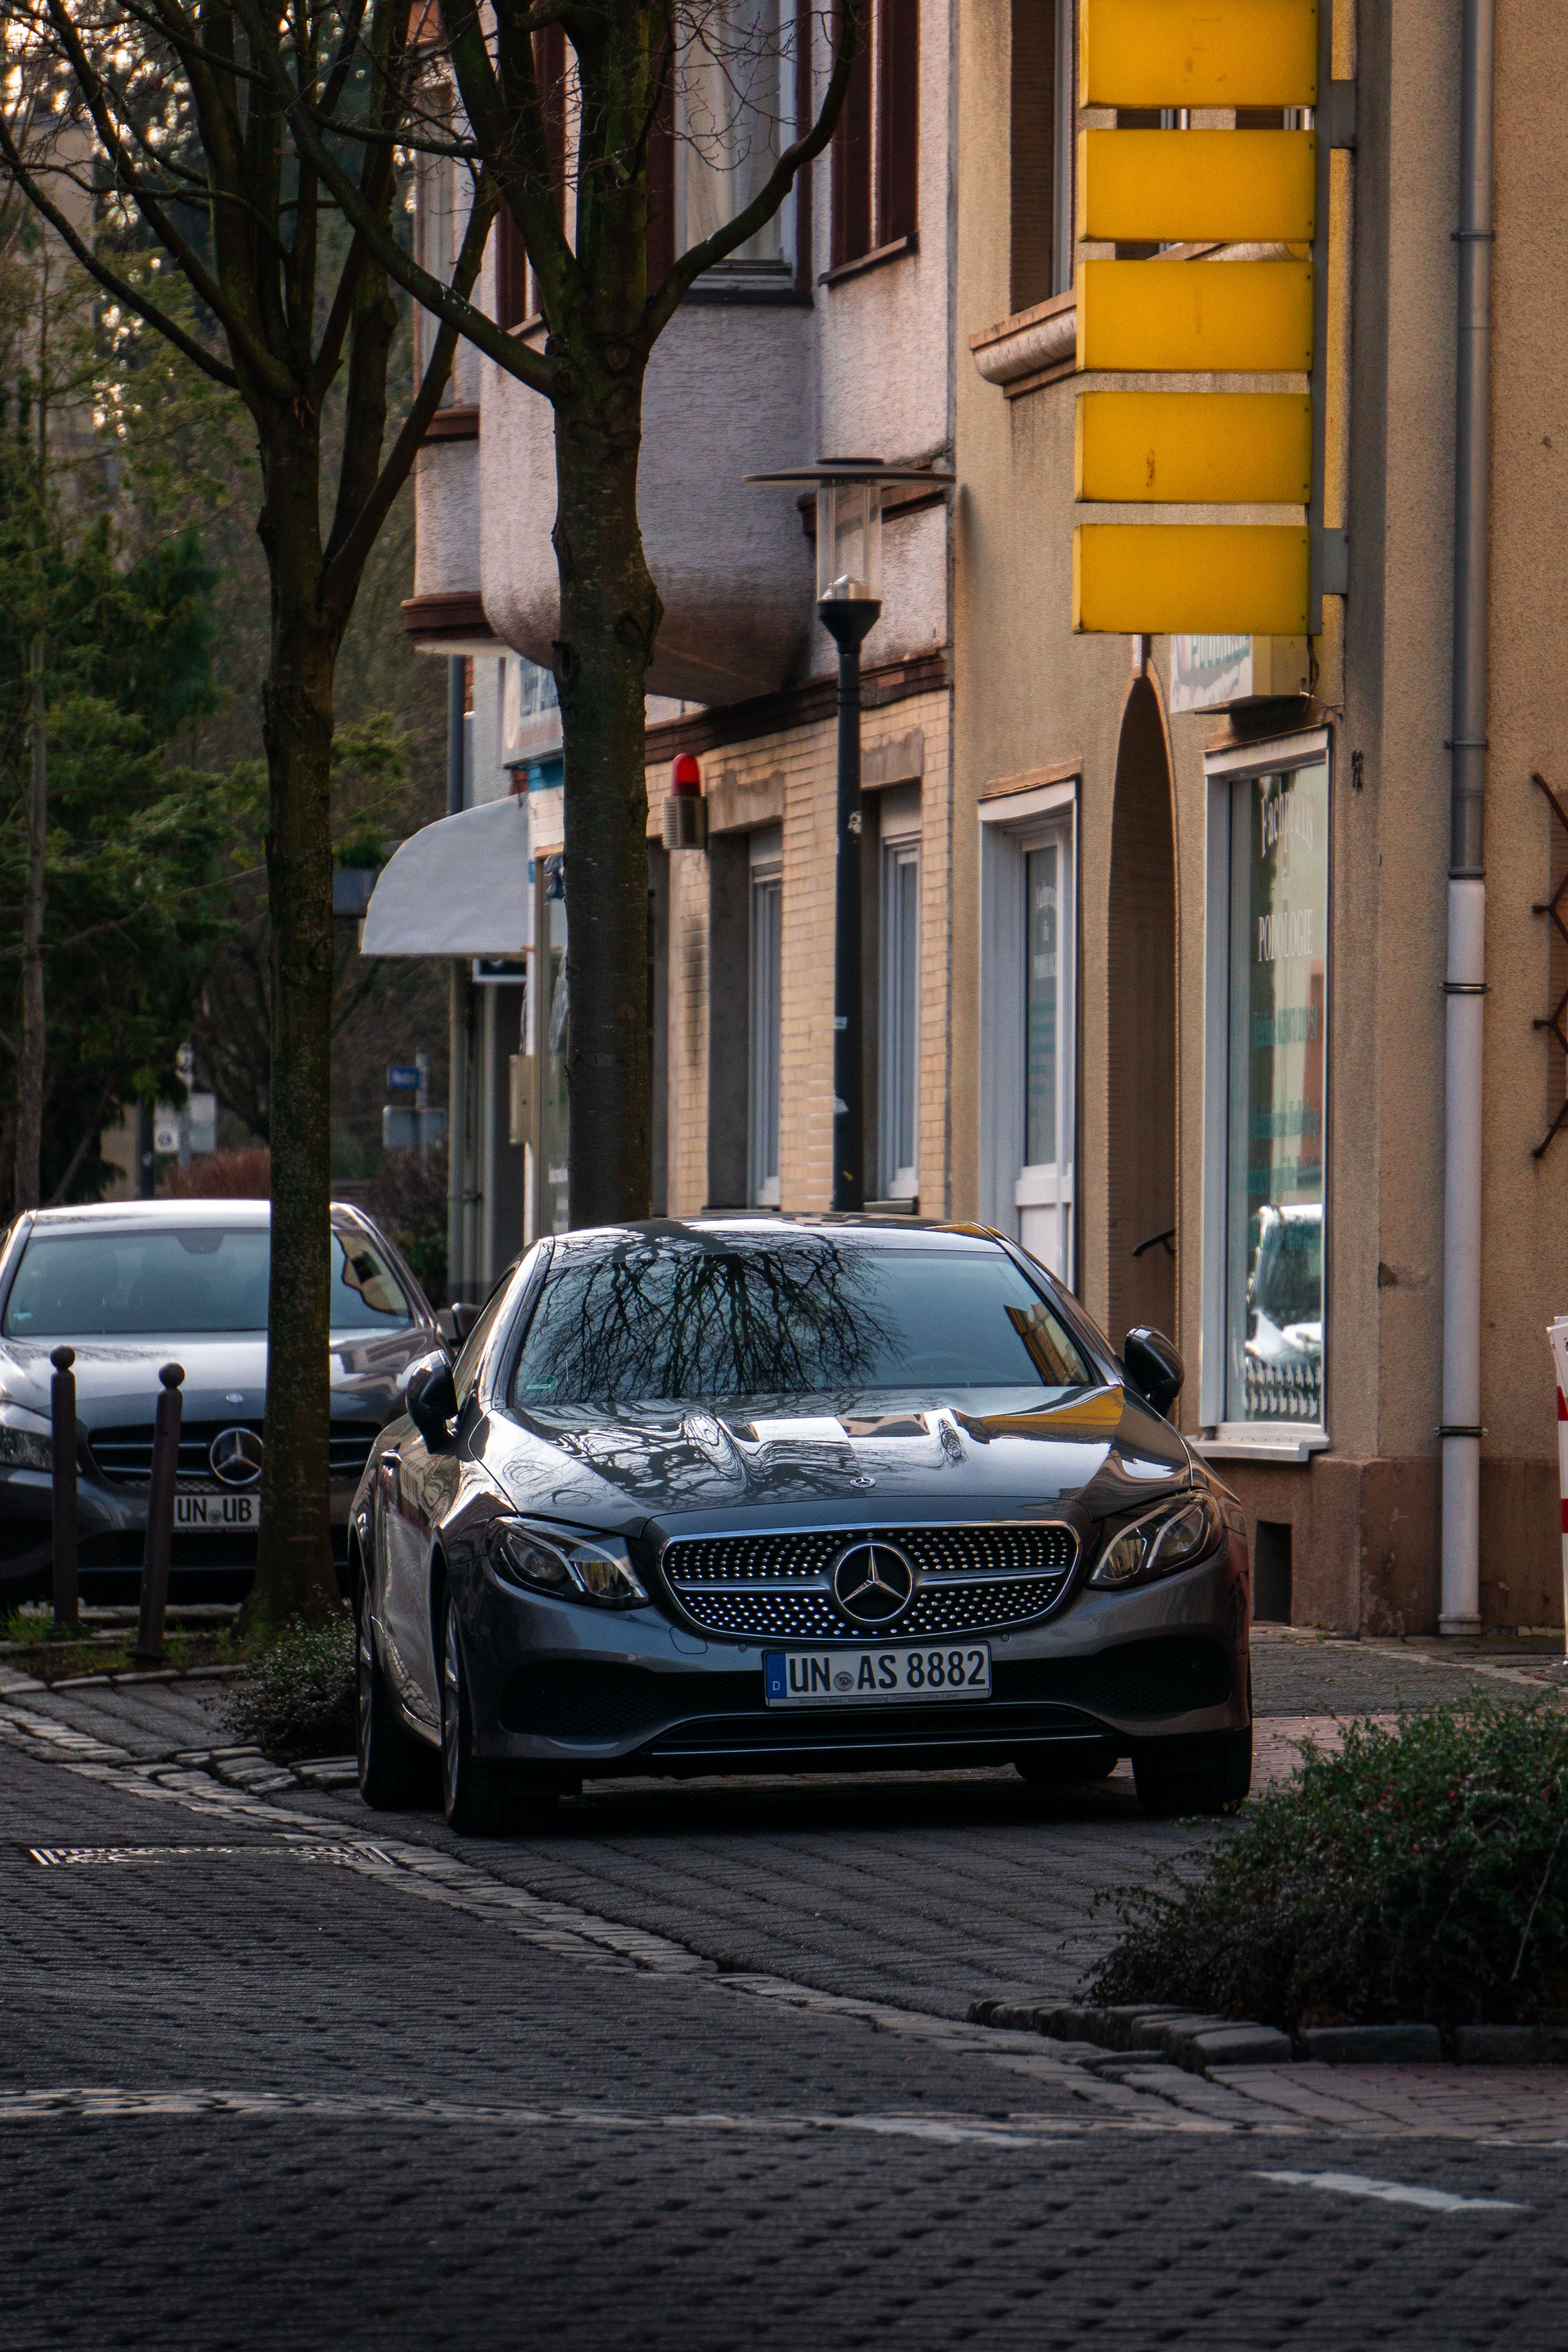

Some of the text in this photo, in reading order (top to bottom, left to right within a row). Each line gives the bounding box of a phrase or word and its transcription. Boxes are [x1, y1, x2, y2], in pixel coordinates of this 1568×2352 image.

[1258, 909, 1313, 962] PODOLOGIE
[178, 1498, 252, 1522] UN UB
[773, 1681, 780, 1690] D
[789, 1650, 985, 1691] UN AS 8882
